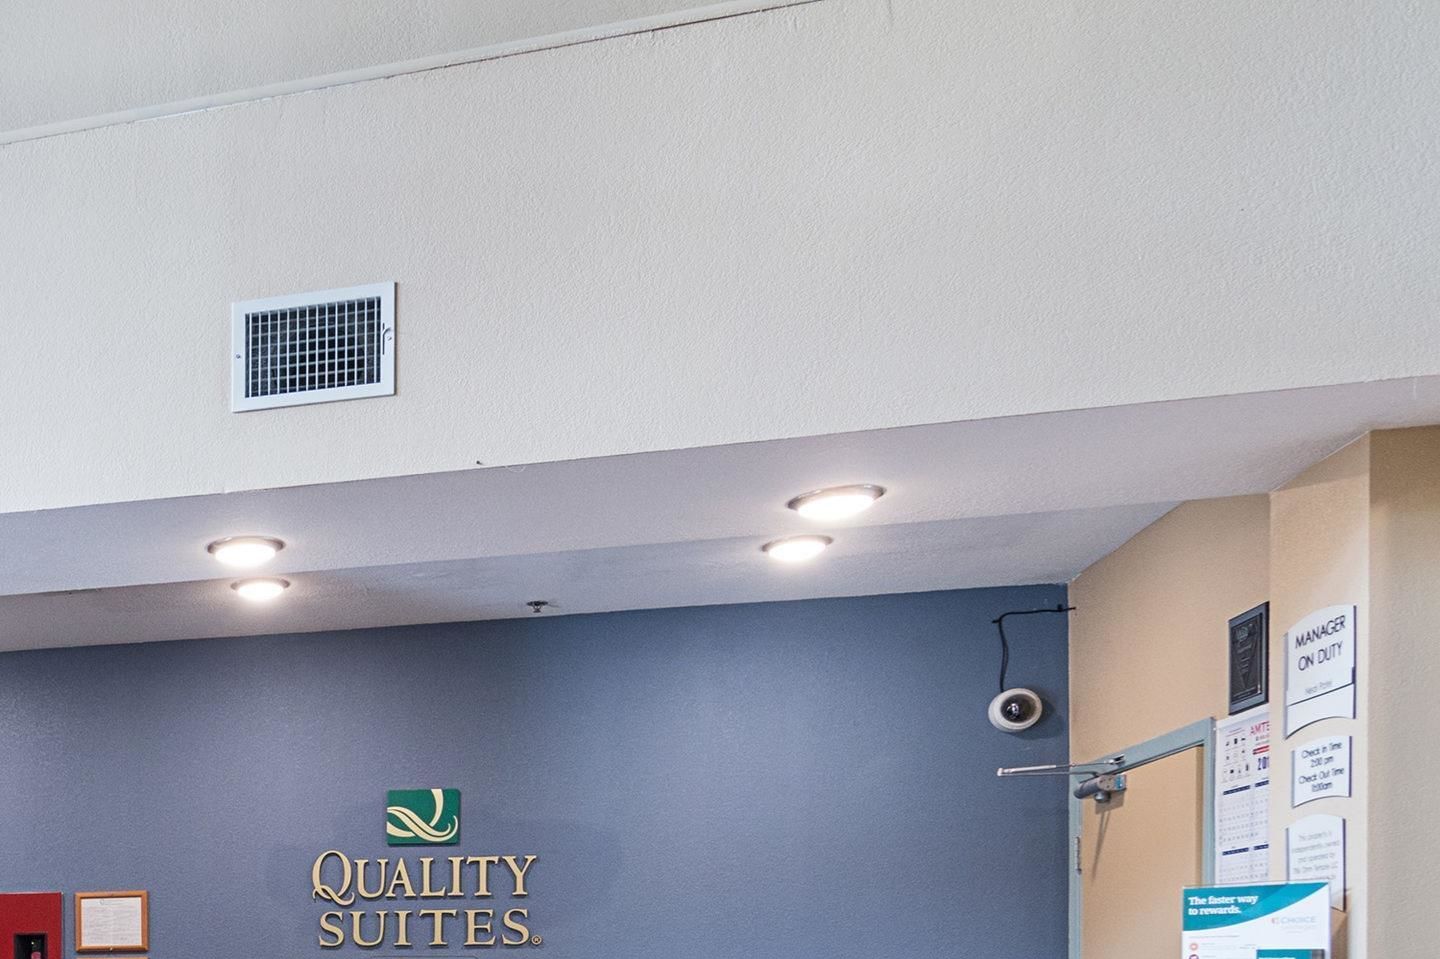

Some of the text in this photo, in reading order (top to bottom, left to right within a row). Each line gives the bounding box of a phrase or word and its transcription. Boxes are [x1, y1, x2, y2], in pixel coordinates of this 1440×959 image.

[1295, 615, 1345, 648] MANAGER
[1298, 641, 1343, 671] ON DUTY
[1301, 748, 1320, 759] Check
[1329, 742, 1342, 751] Time
[1298, 767, 1345, 784] Check Out Time
[312, 850, 537, 906] QUALITY
[1188, 895, 1259, 906] The faster way
[1188, 905, 1242, 915] to rewards.
